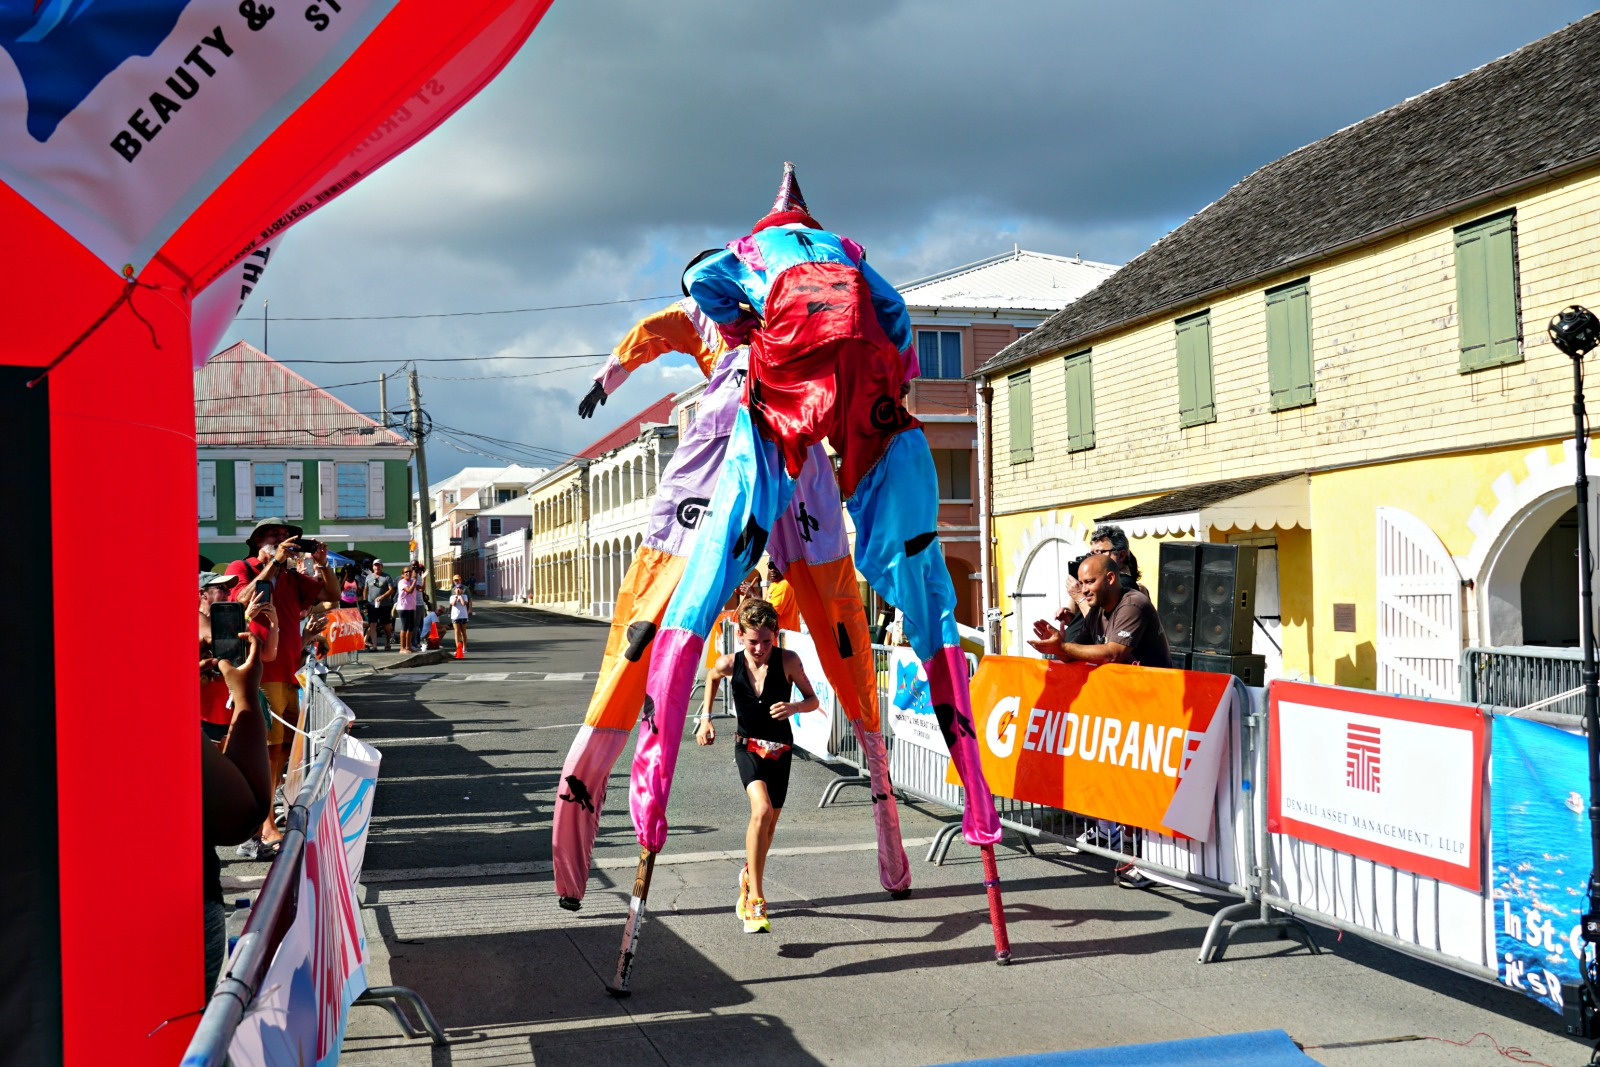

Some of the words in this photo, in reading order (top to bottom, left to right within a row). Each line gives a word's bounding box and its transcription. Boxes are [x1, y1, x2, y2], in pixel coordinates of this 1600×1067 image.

[110, 26, 234, 163] BEAUTY
[239, 0, 275, 31] &
[1022, 707, 1206, 779] ENDURANCE
[1286, 797, 1318, 816] DENALI
[1322, 808, 1347, 825] ASSET
[1352, 815, 1433, 848] MANAGEMENT,
[1439, 837, 1465, 854] LLLP
[1503, 900, 1522, 941] In
[1526, 909, 1564, 954] St.
